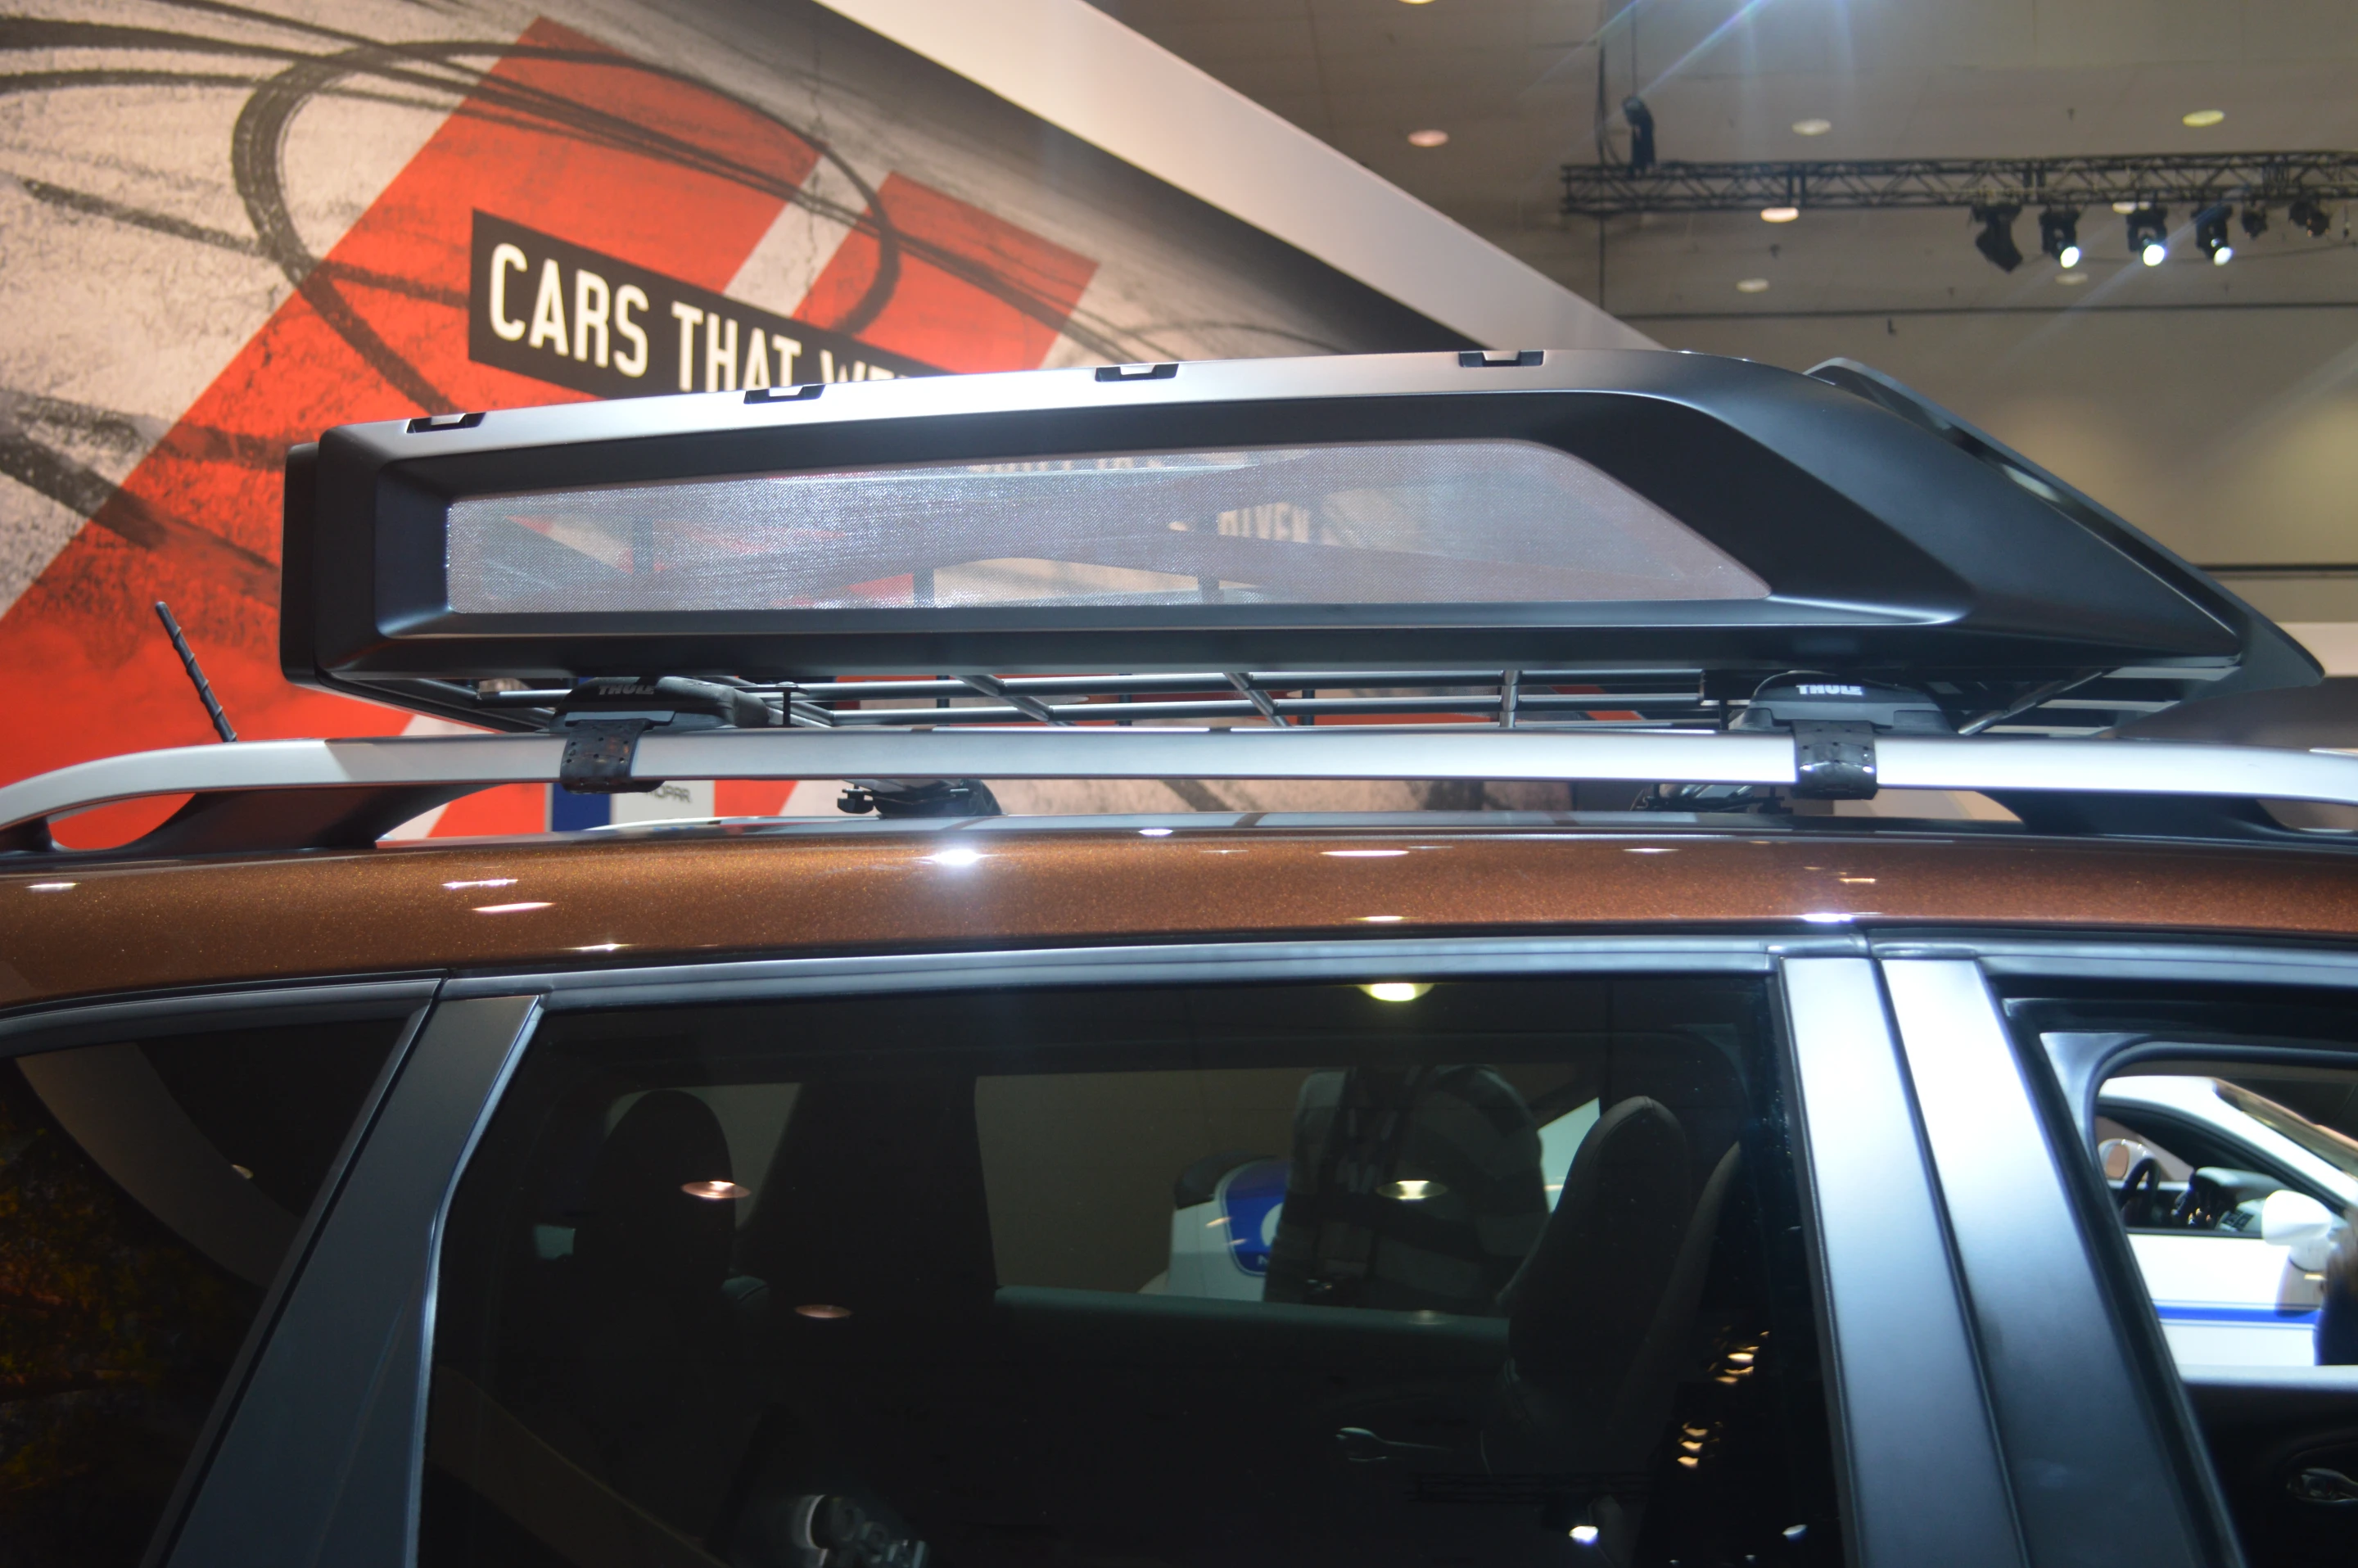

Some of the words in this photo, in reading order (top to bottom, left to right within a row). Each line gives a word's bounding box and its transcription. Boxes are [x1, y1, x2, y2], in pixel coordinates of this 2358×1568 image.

[490, 242, 649, 378] CARS
[671, 300, 802, 393] THAT
[599, 685, 654, 695] THULE
[1796, 685, 1863, 696] THULE
[645, 784, 691, 803] OPAR
